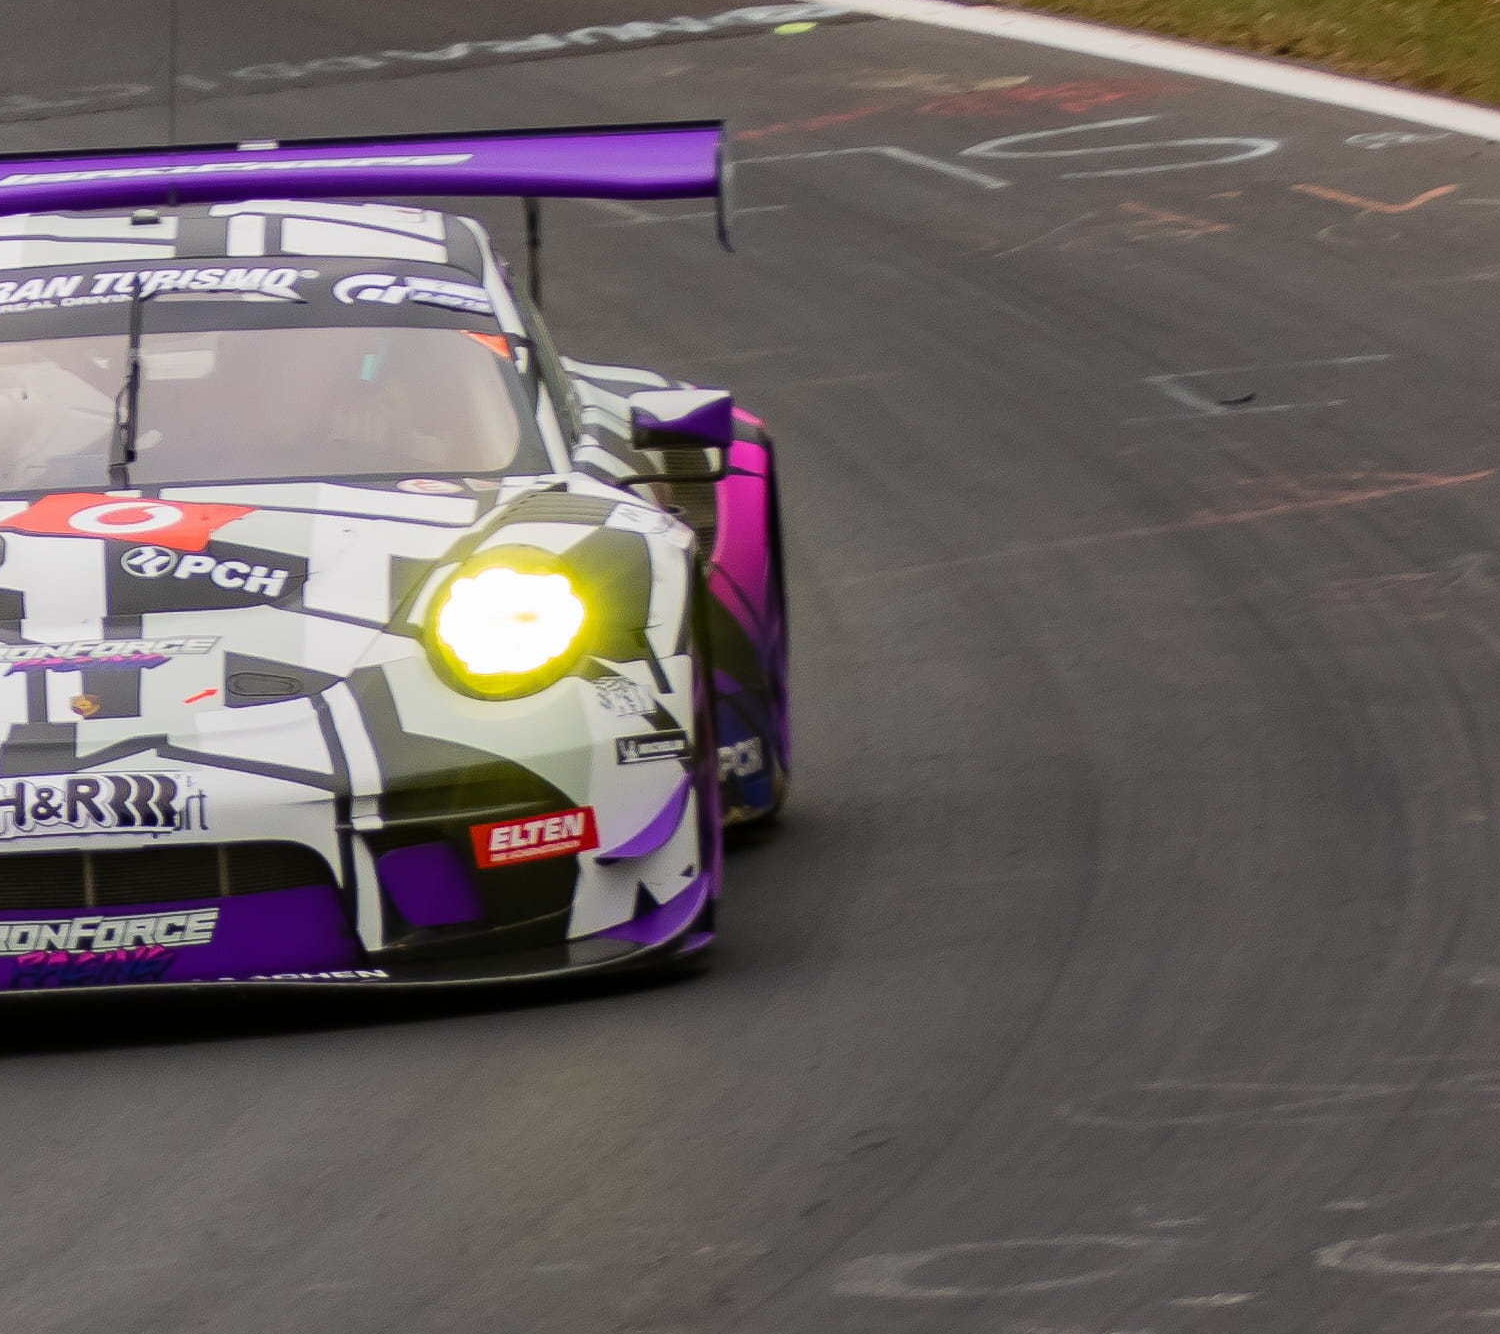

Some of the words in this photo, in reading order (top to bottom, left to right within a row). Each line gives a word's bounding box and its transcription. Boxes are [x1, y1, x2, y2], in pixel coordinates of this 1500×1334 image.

[92, 266, 303, 303] TURISMO
[173, 553, 290, 598] PCH
[488, 811, 585, 853] ELTEN
